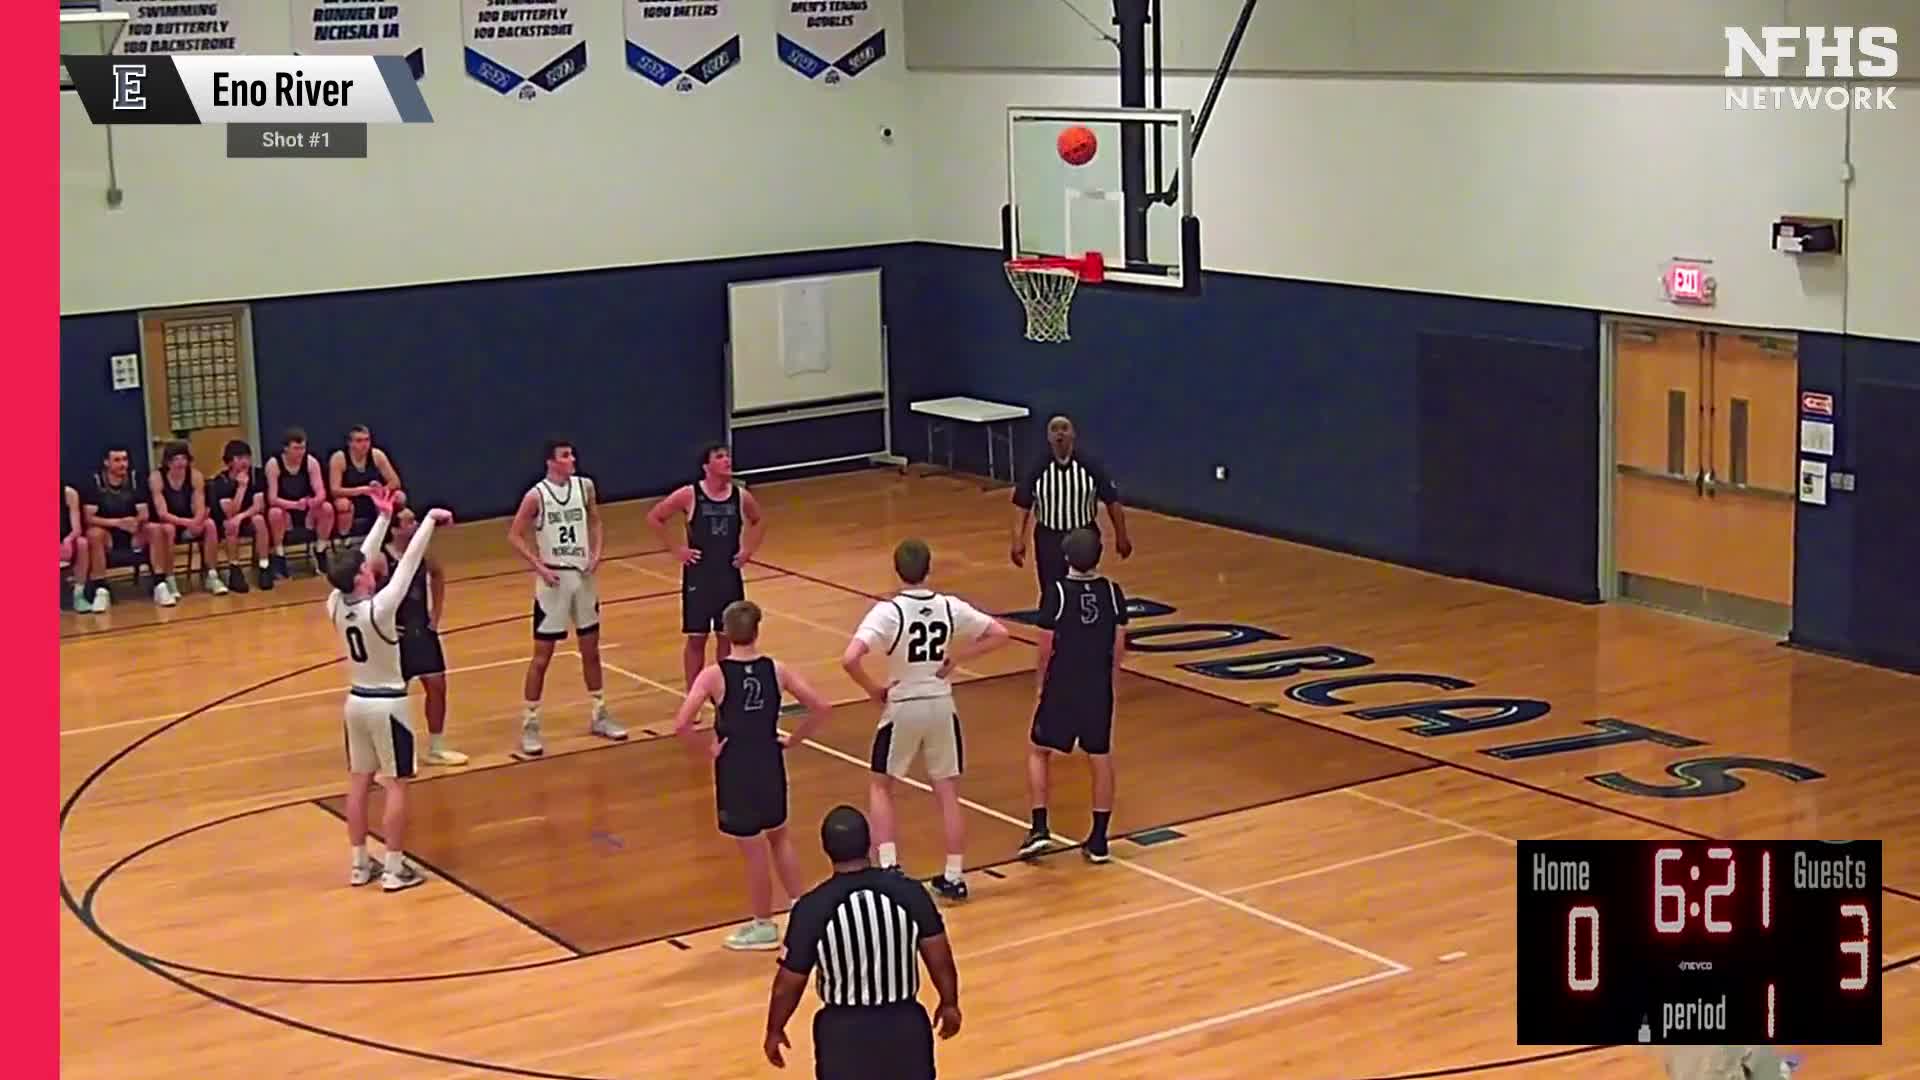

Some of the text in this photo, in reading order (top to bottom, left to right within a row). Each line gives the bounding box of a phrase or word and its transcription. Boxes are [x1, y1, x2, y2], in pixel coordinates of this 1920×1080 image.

[137, 4, 218, 18] SWIMMING
[312, 6, 399, 22] RUNNER UP
[478, 8, 568, 23] 100 BUTTERFLY
[643, 6, 672, 19] 1000
[128, 21, 229, 36] 100 BUTTERFLY
[474, 27, 496, 39] 100
[559, 526, 577, 544] 24
[1080, 593, 1099, 624] 5
[346, 626, 368, 662] 0
[908, 621, 947, 663] 22
[743, 677, 764, 711] 2
